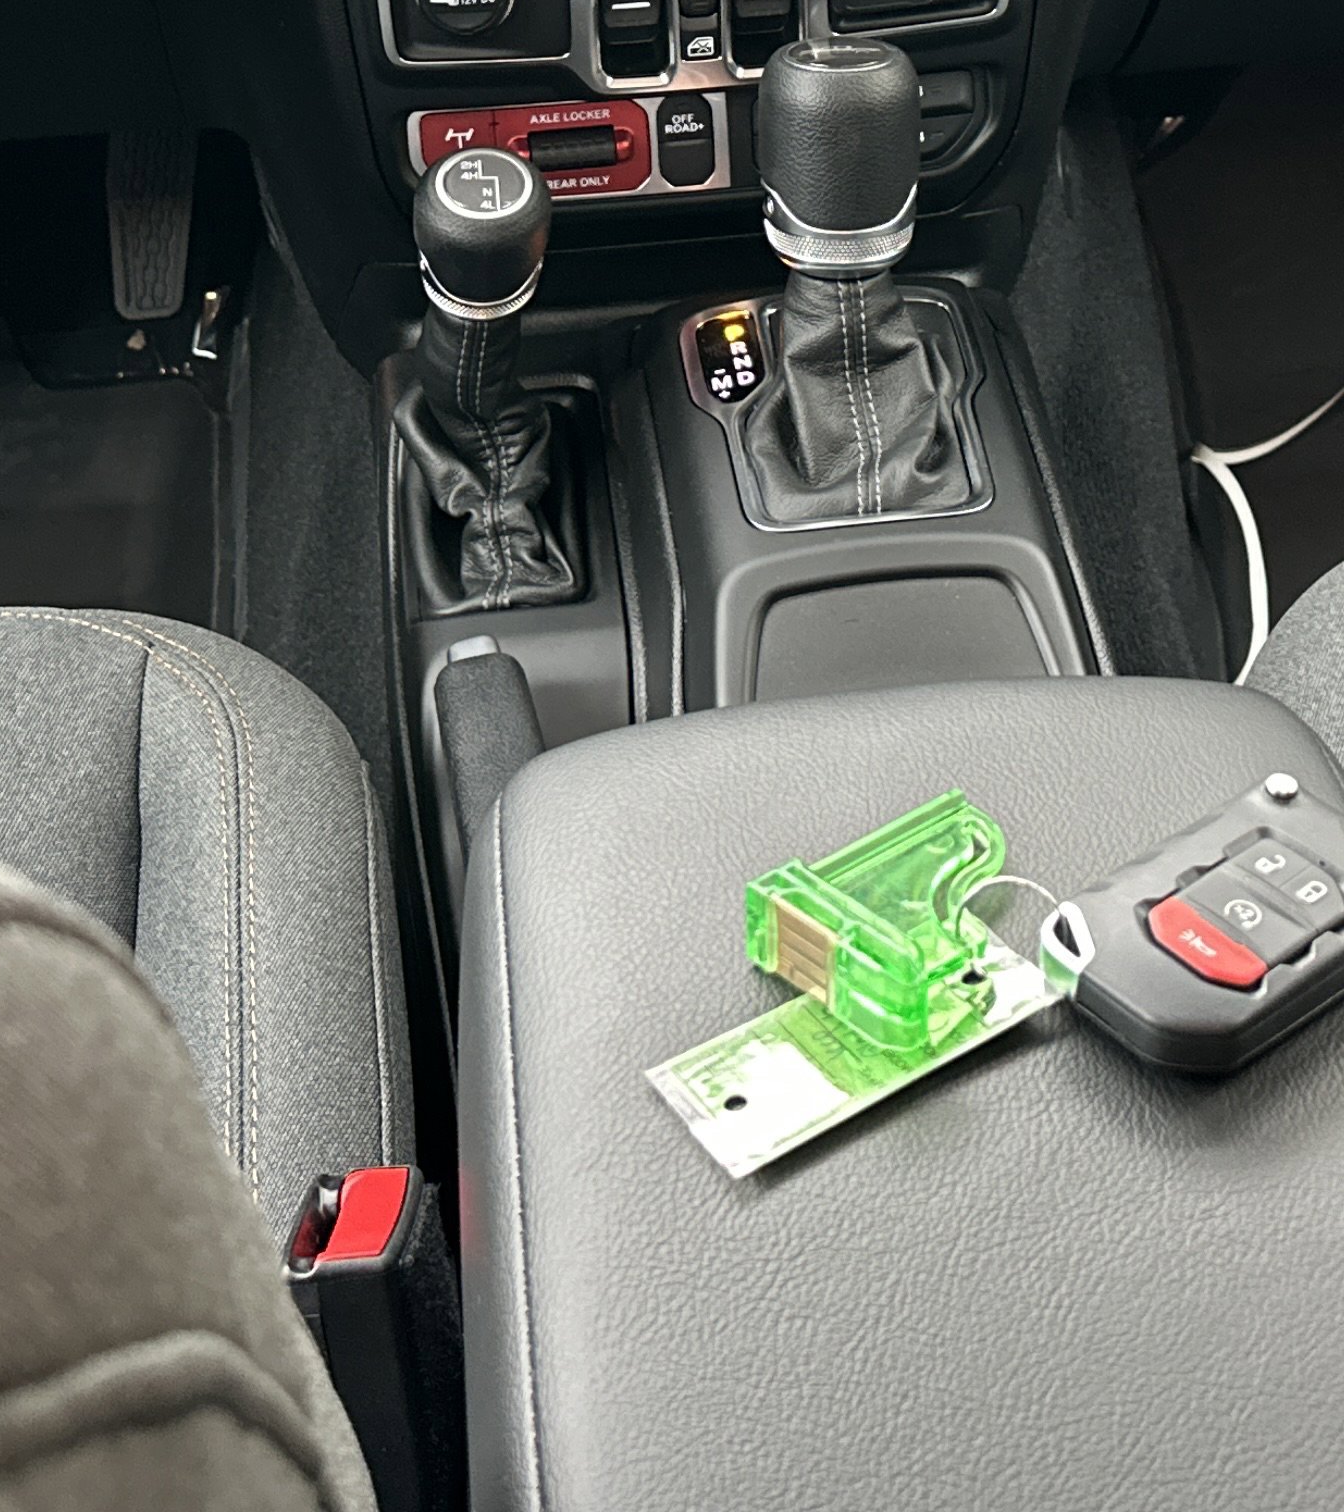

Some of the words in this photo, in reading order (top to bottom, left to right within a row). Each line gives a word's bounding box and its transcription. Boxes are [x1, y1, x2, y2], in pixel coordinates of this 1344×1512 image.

[530, 111, 560, 124] AXLE
[562, 108, 611, 122] LOCKER
[672, 113, 695, 124] OFF
[460, 160, 478, 170] 2H
[460, 171, 478, 180] 4H
[547, 177, 577, 189] REAR
[579, 175, 611, 188] ONLY
[482, 188, 493, 196] N
[480, 201, 495, 210] 4L
[729, 341, 748, 356] R
[733, 354, 753, 370] N
[711, 374, 734, 391] M
[736, 371, 756, 386] D
